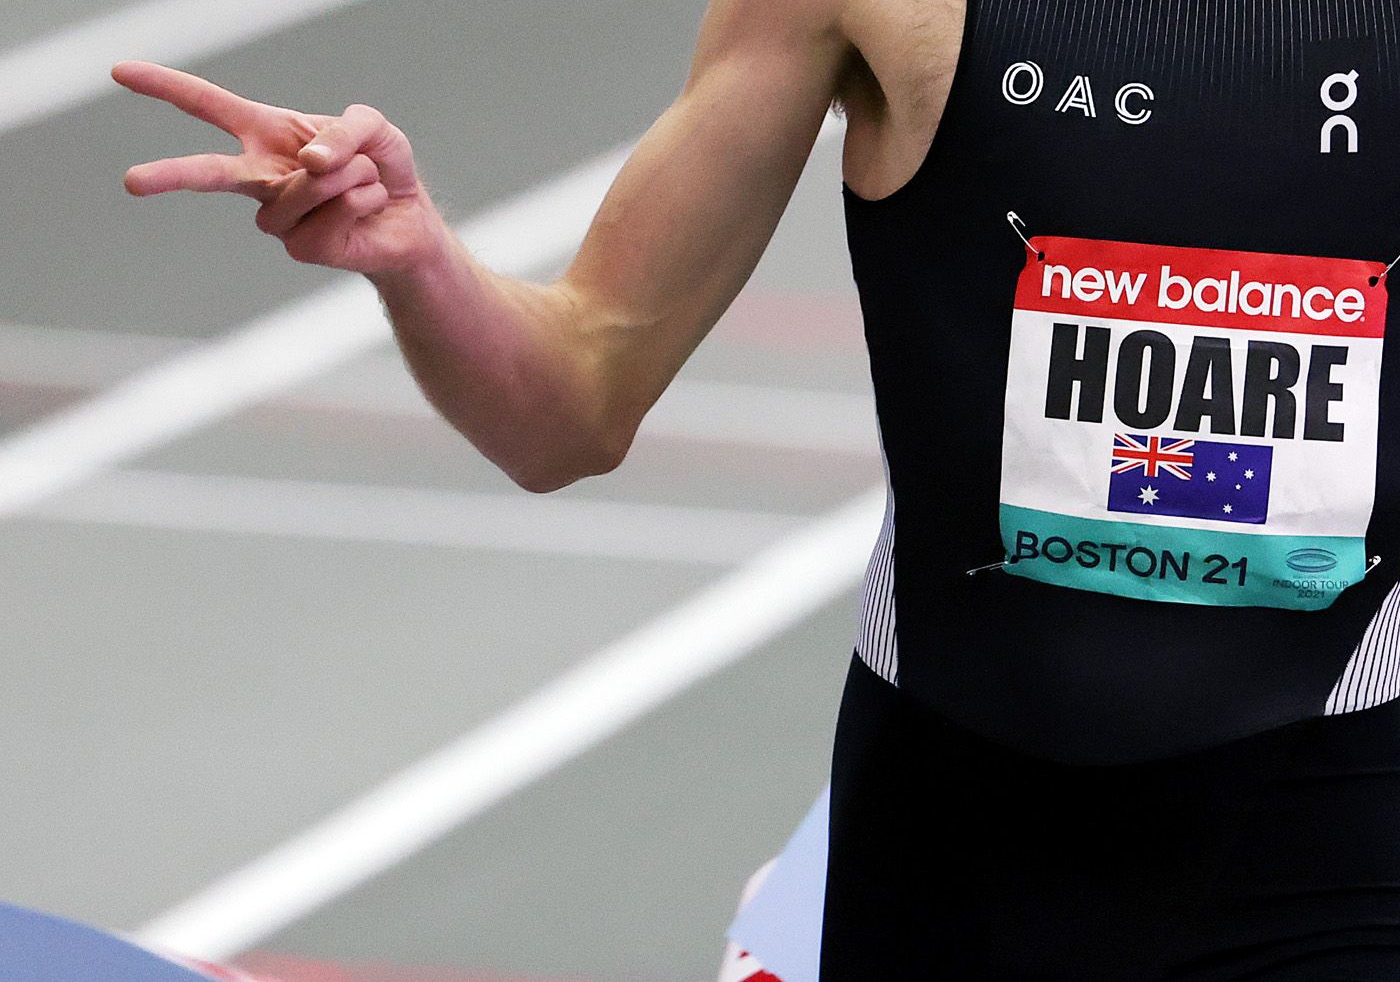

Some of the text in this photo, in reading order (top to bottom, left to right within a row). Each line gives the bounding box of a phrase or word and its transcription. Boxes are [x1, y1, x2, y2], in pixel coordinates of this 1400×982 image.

[1001, 60, 1155, 125] OAC
[1041, 263, 1366, 323] new balance
[1044, 322, 1349, 443] HOARE
[1015, 530, 1248, 587] BOSTON 21
[1272, 579, 1317, 589] INDOOR
[1297, 590, 1325, 599] 2021
